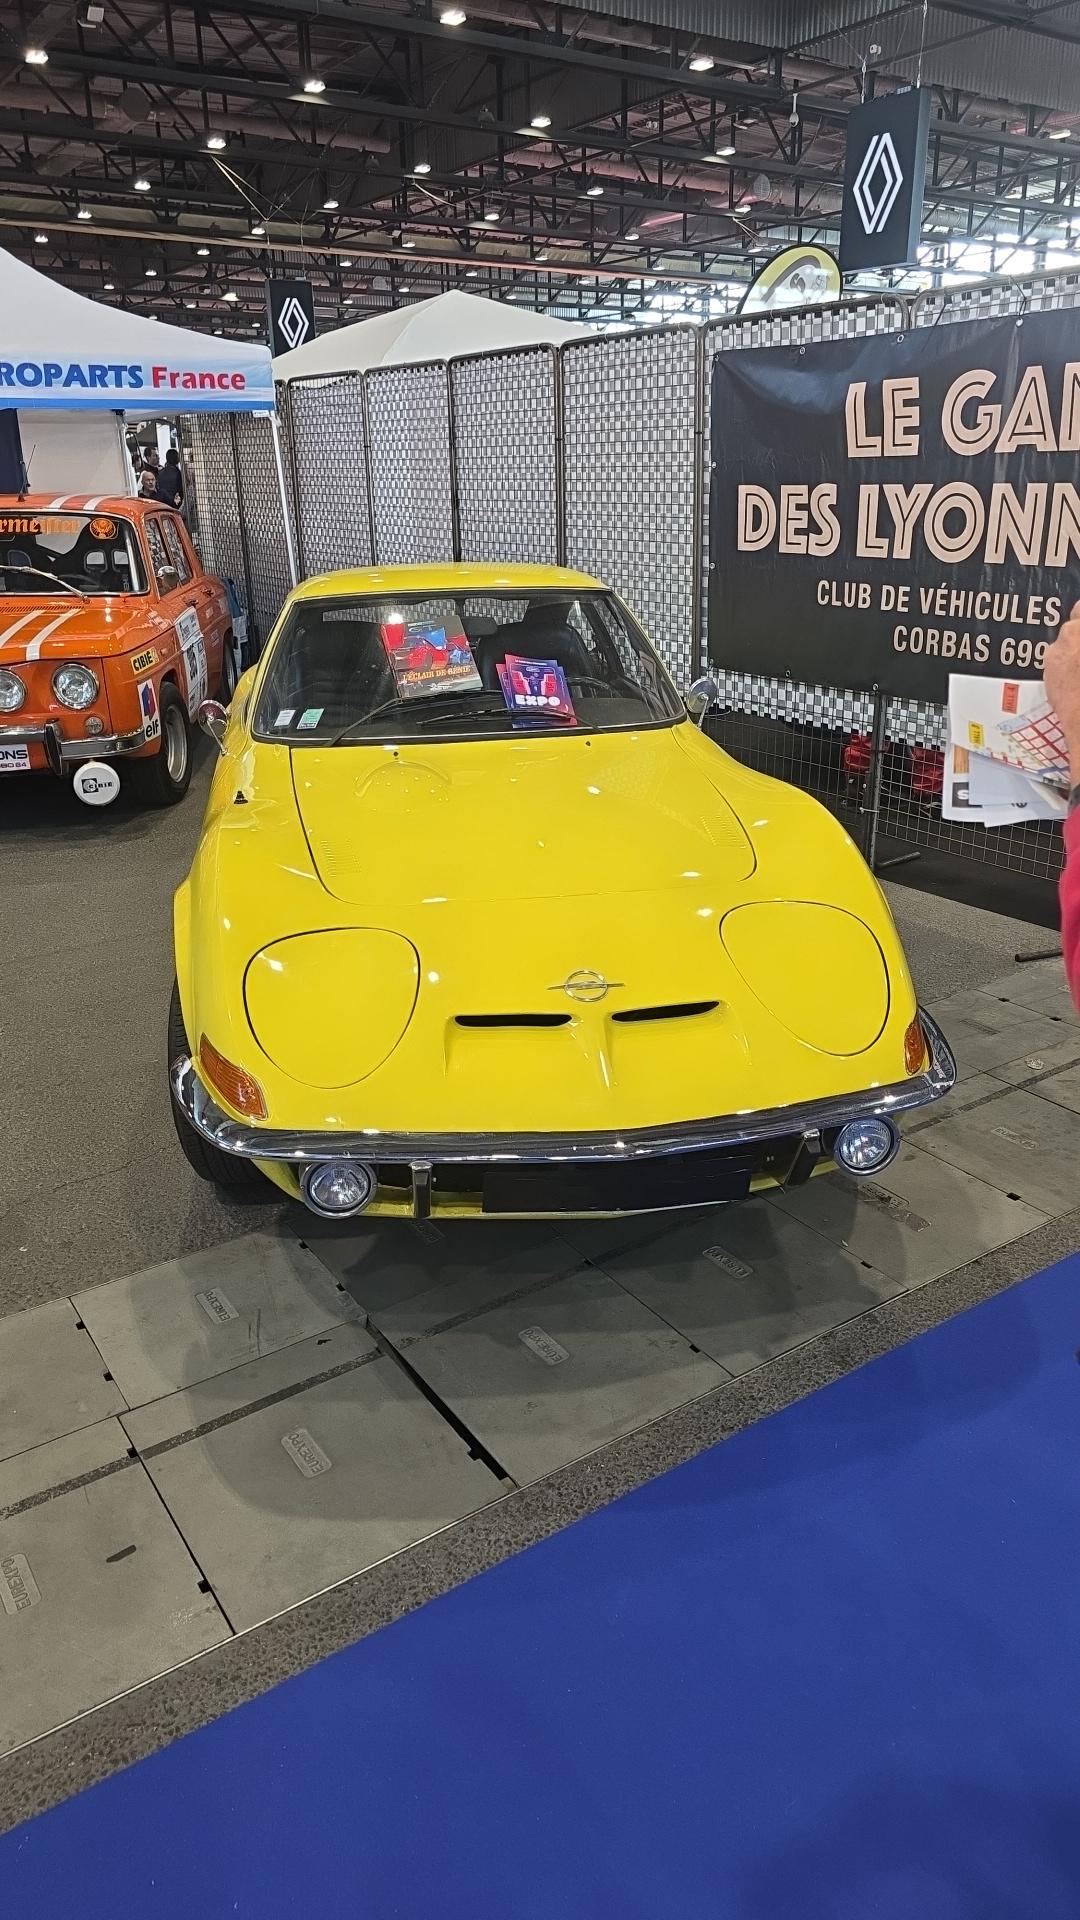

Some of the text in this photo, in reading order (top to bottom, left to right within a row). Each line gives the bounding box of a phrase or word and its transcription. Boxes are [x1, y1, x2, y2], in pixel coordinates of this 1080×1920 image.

[0, 362, 246, 391] ROPARTS France
[845, 376, 920, 458] LE
[737, 482, 841, 557] DES
[817, 579, 1062, 627] CLUB DE VÉHICULES
[893, 625, 991, 662] CORBAS
[514, 694, 561, 706] EXPO
[145, 719, 160, 738] elf
[524, 1329, 562, 1362] EUREXPO
[287, 1433, 324, 1473] EUREXPO
[1, 1558, 32, 1611] EUREXPO
